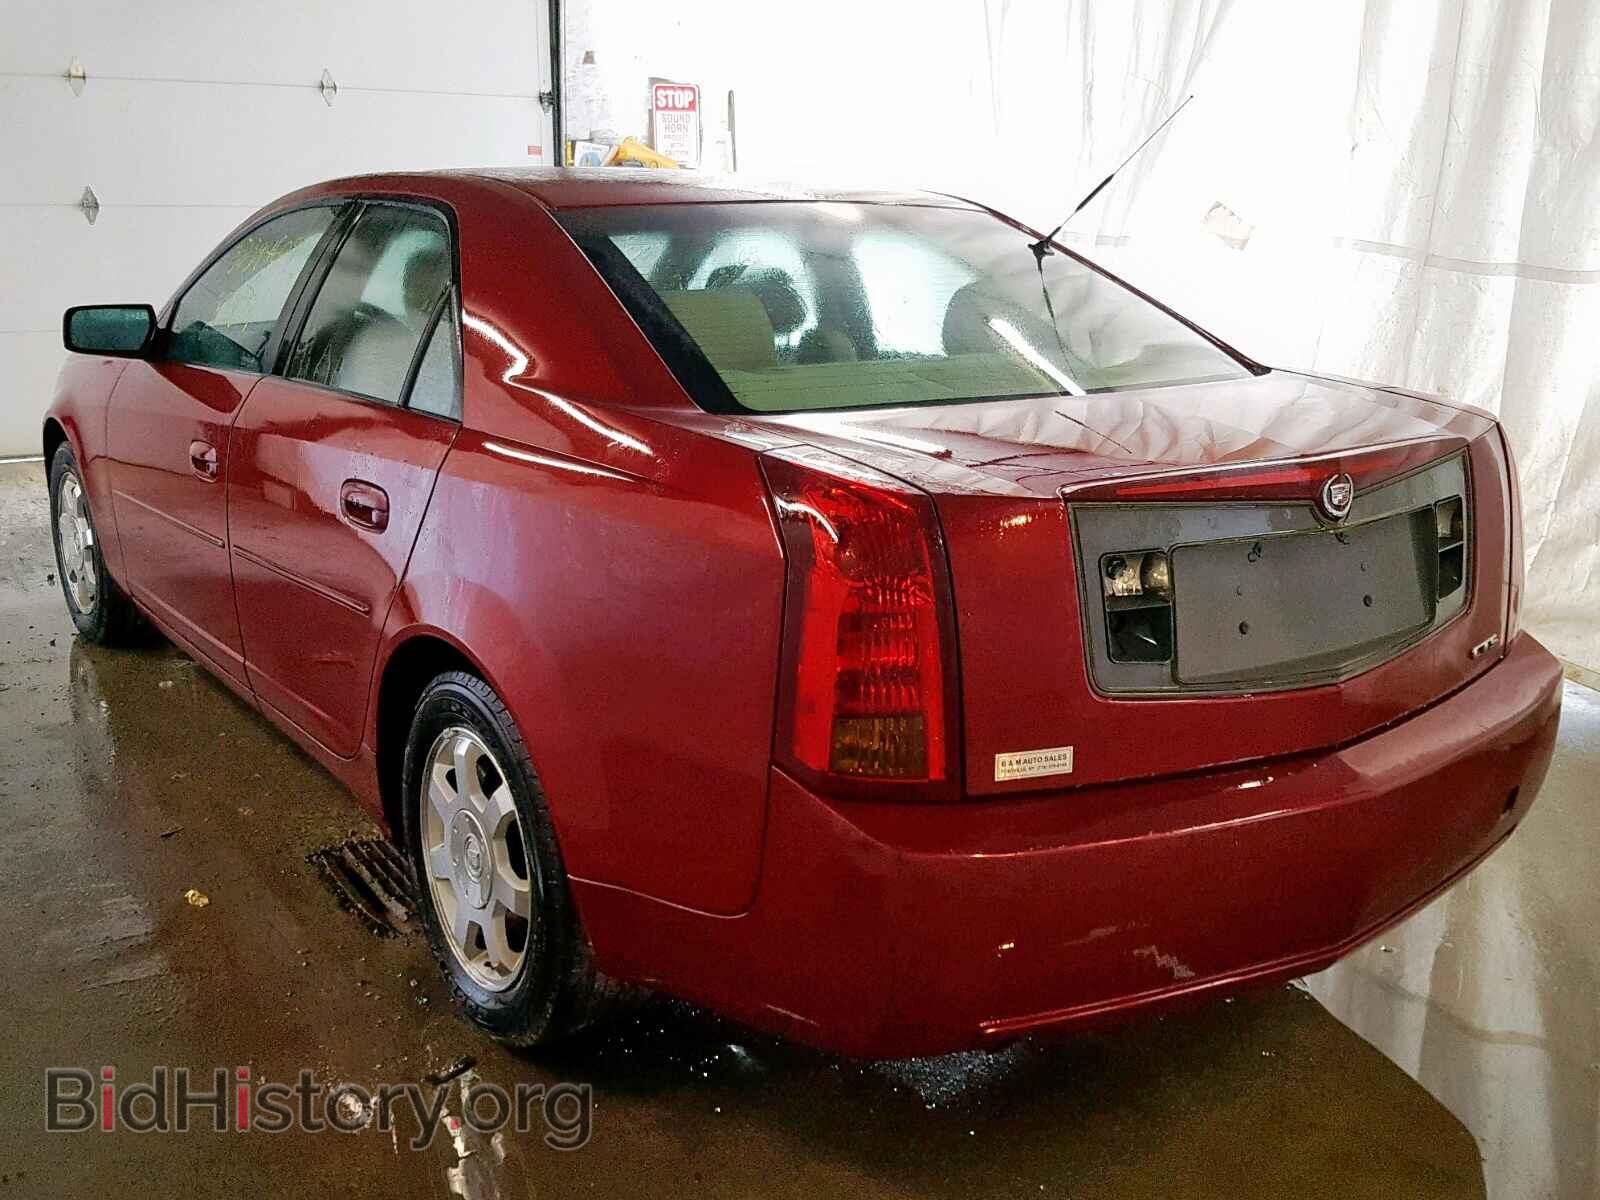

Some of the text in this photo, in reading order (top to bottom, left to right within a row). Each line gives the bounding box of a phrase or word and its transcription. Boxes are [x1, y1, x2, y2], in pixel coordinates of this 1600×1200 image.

[656, 89, 693, 109] STOP
[662, 113, 691, 123] SOUND
[664, 124, 689, 133] HORN
[1022, 757, 1043, 765] AUTO
[1044, 753, 1067, 762] SALES
